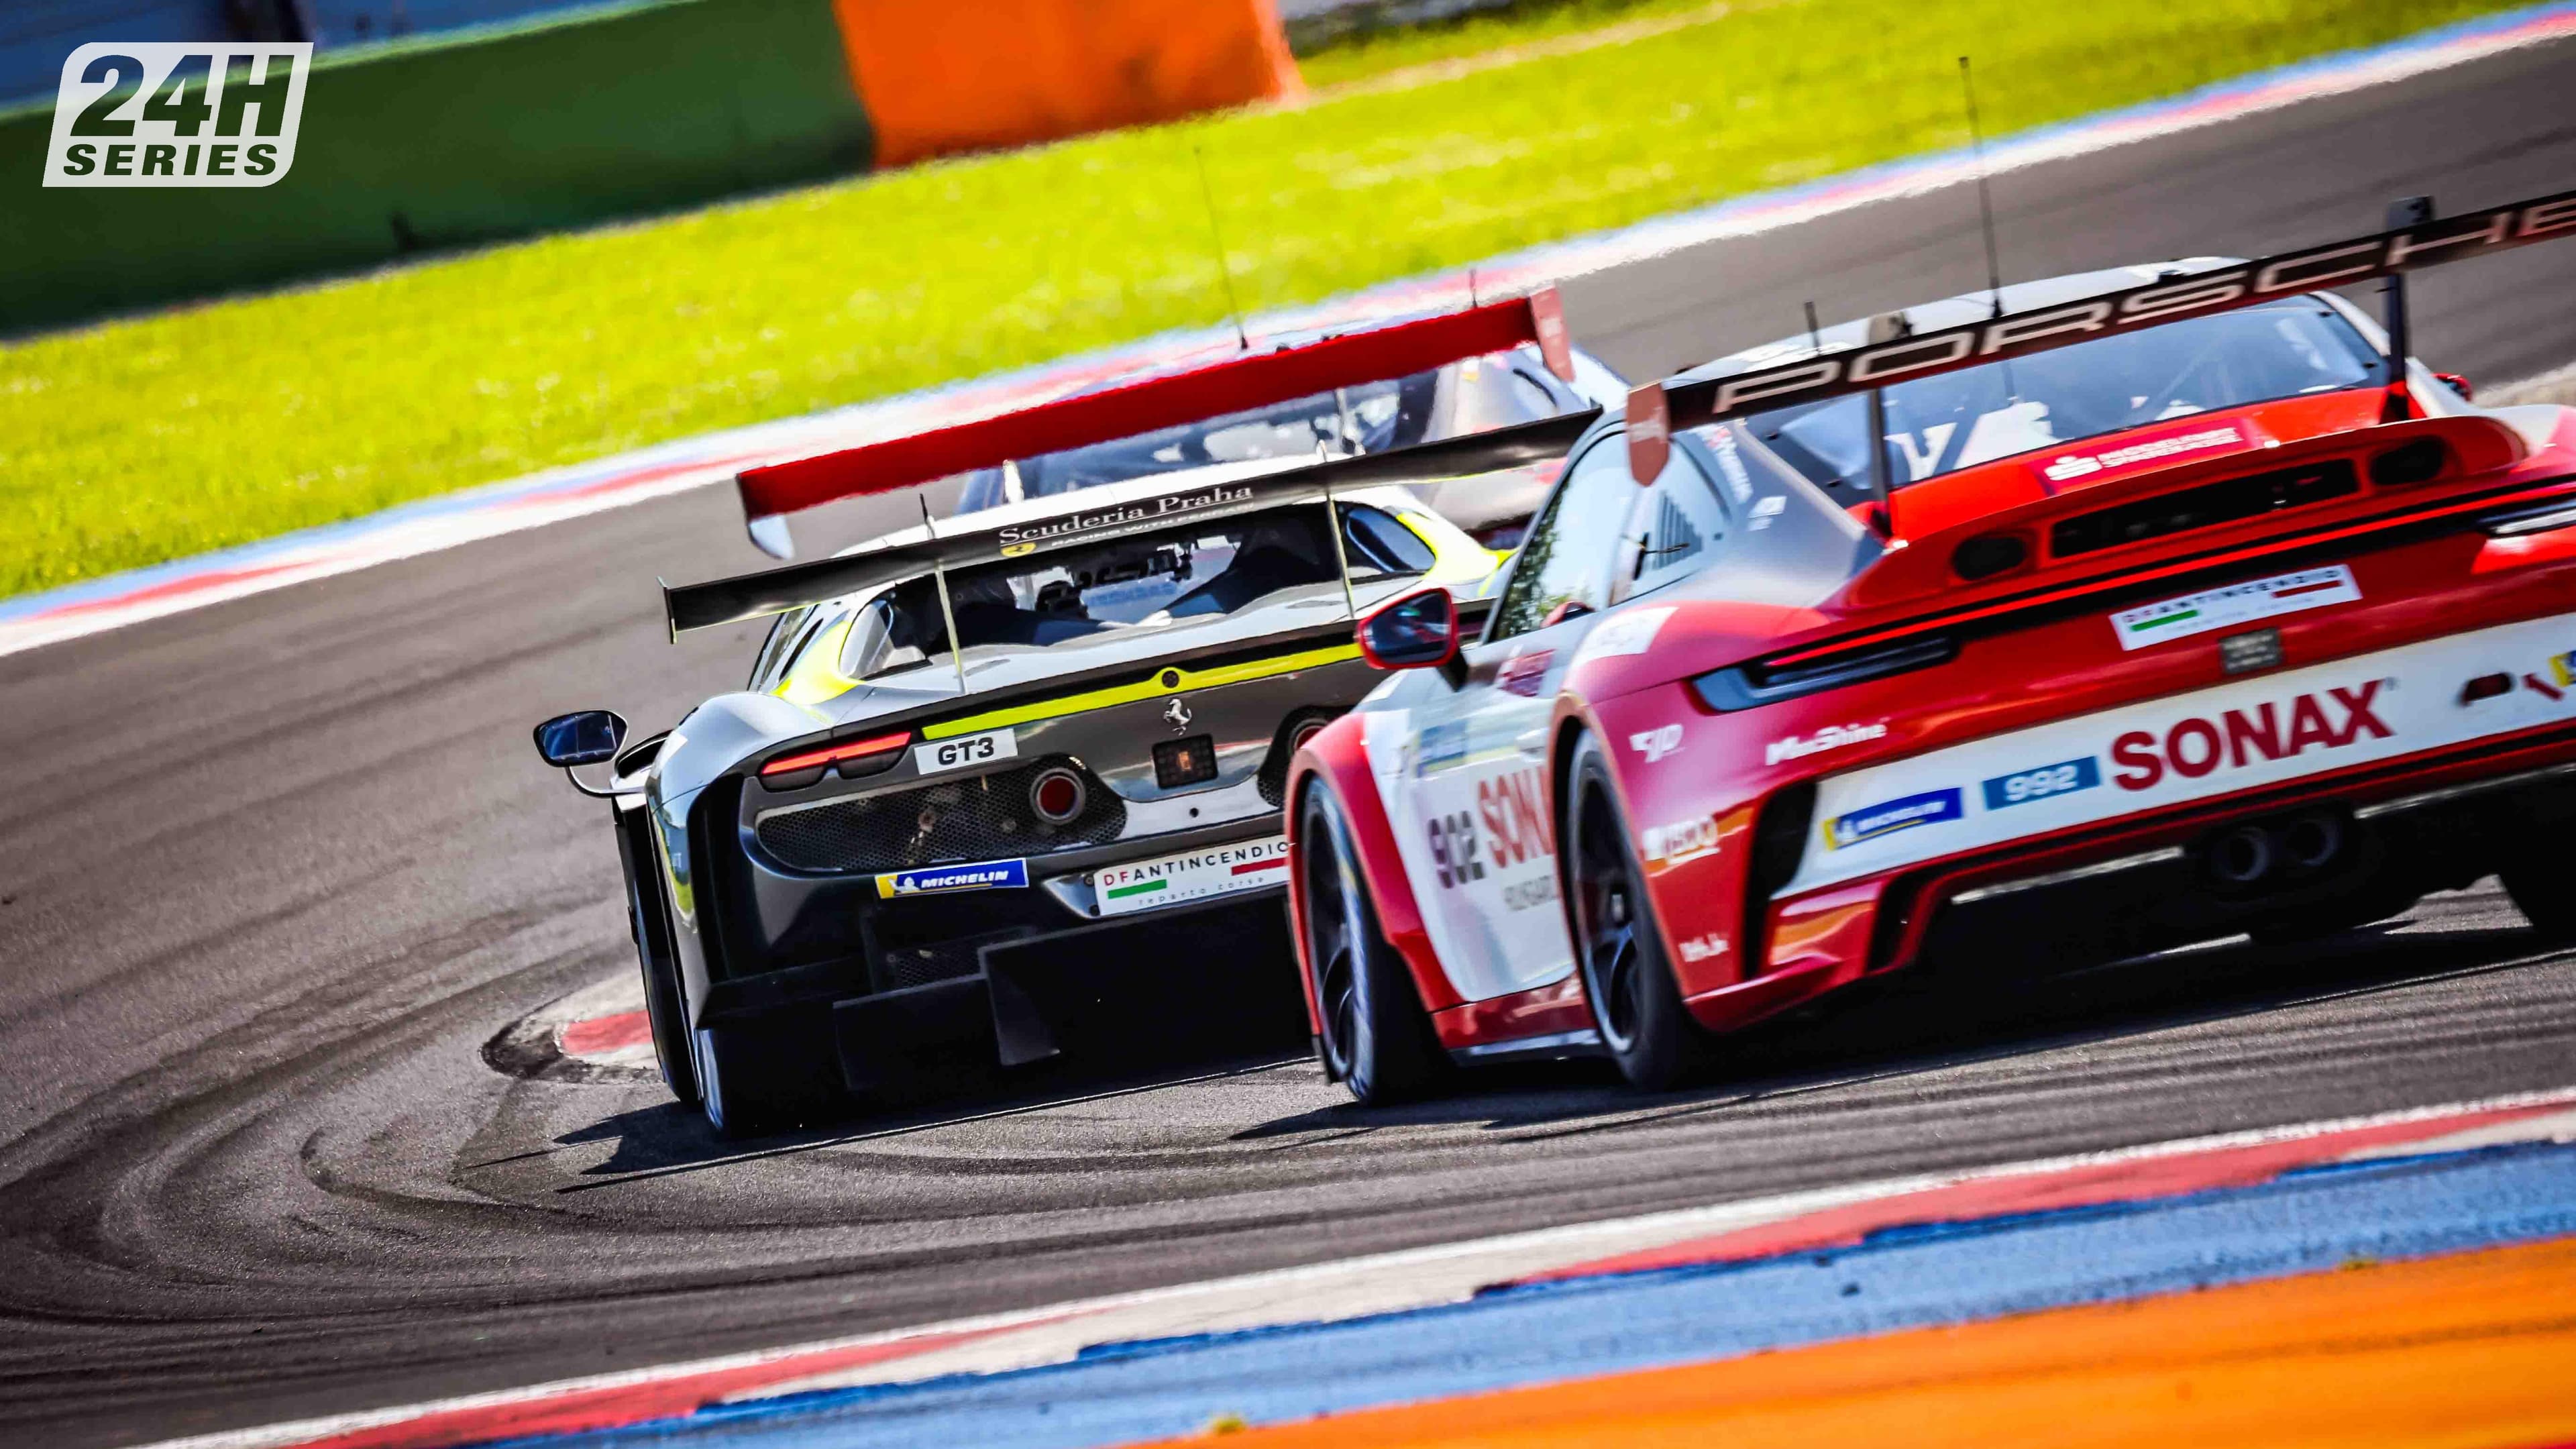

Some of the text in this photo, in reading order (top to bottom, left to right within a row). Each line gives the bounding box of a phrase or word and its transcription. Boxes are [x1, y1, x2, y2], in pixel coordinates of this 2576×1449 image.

[1712, 197, 2576, 414] PORSCHE
[998, 487, 1252, 545] Scuderia Praha
[938, 737, 994, 765] GT3
[2110, 678, 2397, 792] SONAX
[2004, 765, 2078, 802] 992
[1104, 841, 1289, 886] DFANTINCENDIO
[1428, 810, 1486, 890] 902
[920, 871, 1009, 888] MICHELIN
